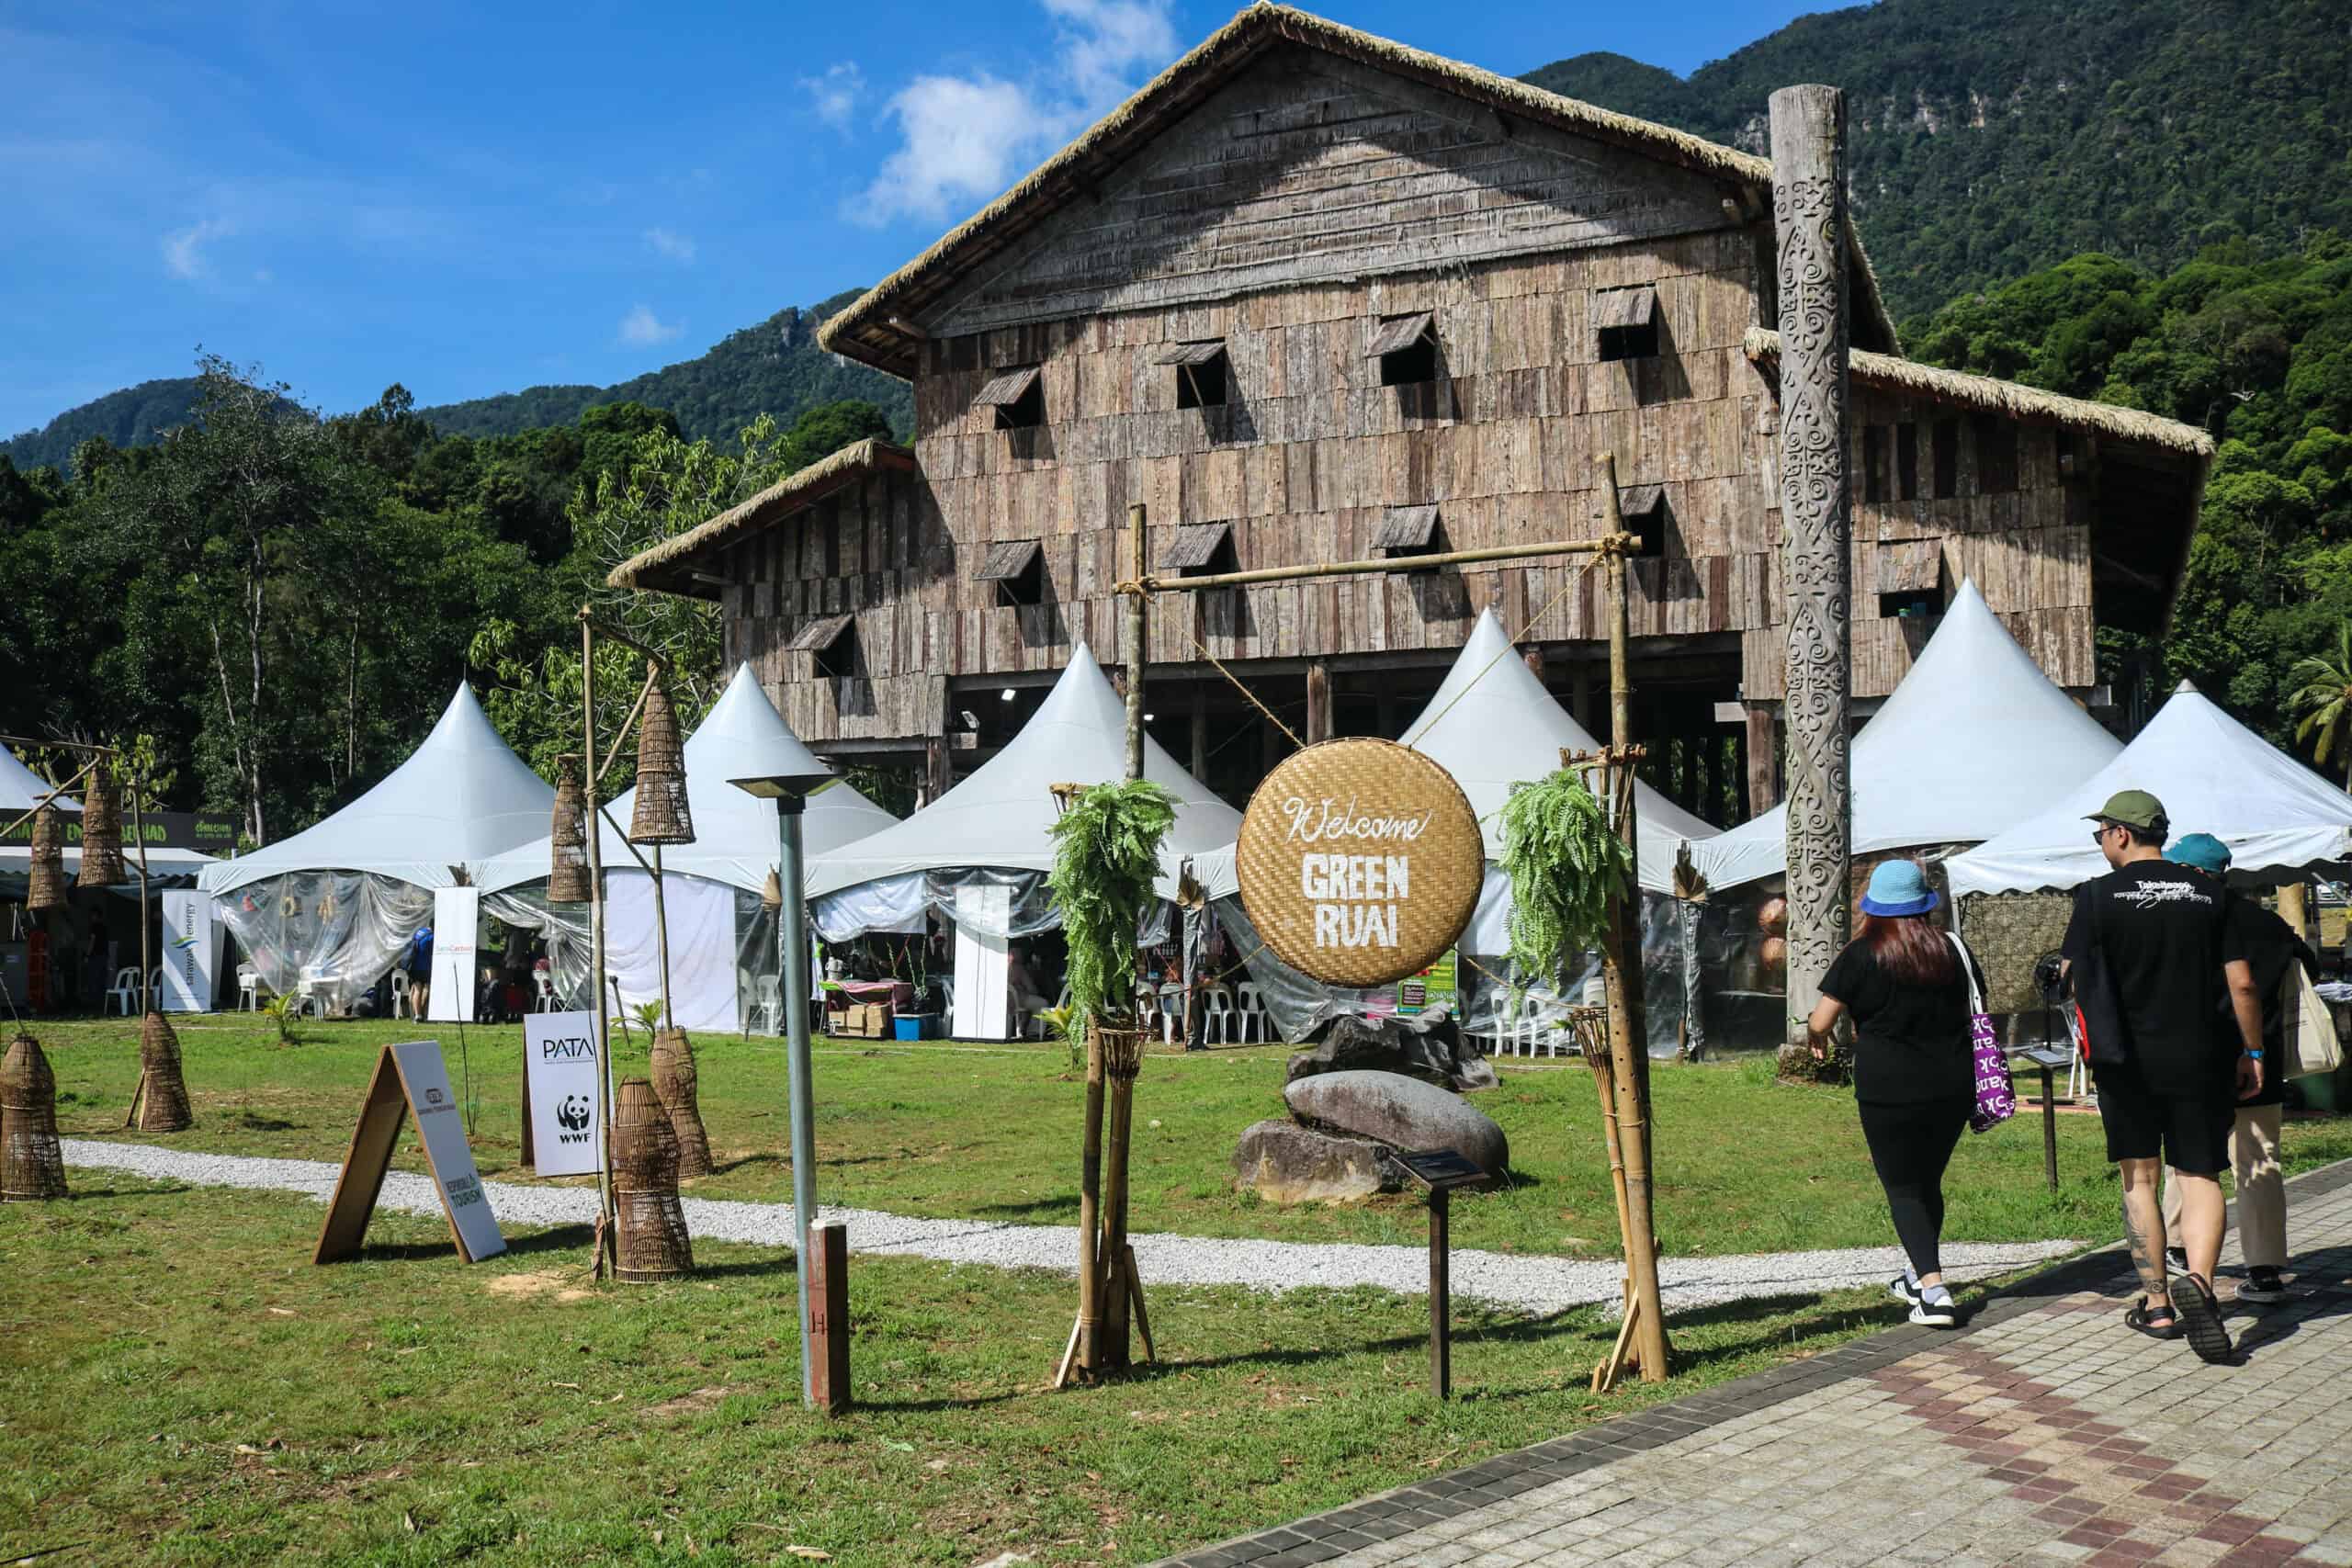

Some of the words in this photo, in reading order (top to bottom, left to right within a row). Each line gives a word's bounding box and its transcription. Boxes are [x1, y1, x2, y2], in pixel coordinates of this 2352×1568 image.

[1283, 795, 1432, 843] Welcome
[1302, 852, 1408, 900] GREEN
[186, 903, 196, 935] energy
[1315, 904, 1397, 948] RUAI
[543, 1037, 594, 1058] PATA
[560, 1132, 589, 1144] WWF
